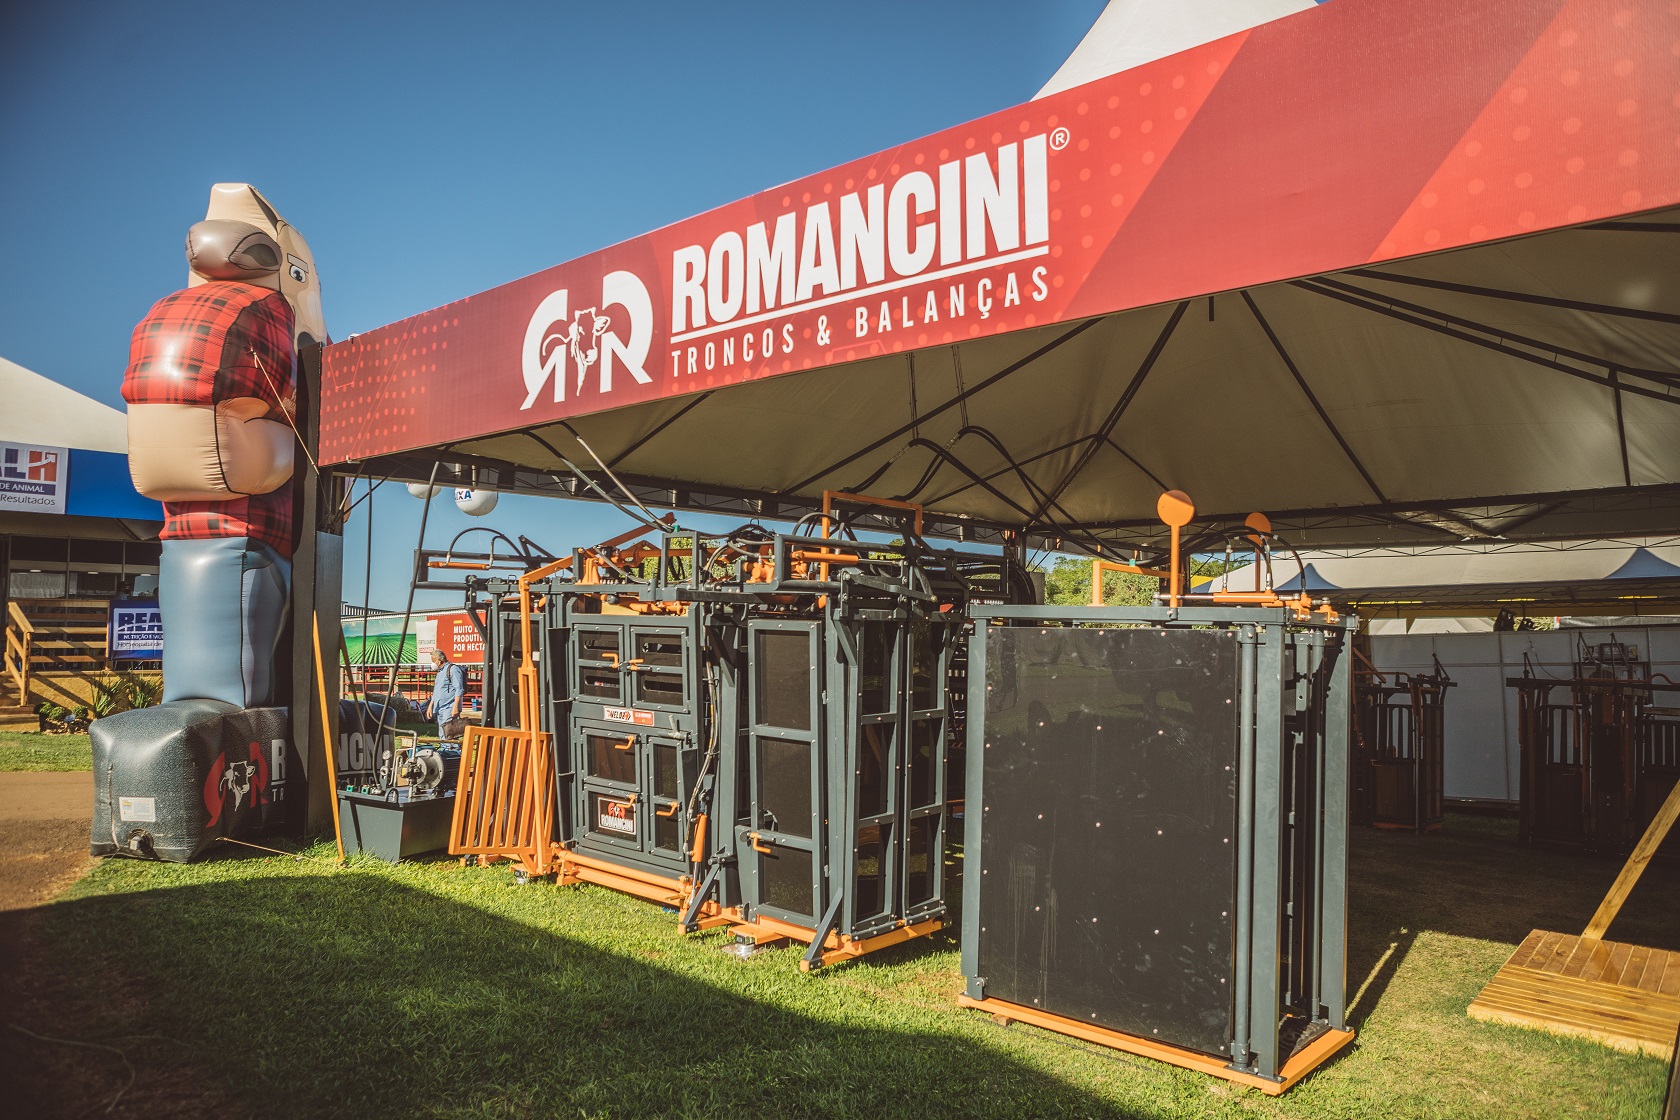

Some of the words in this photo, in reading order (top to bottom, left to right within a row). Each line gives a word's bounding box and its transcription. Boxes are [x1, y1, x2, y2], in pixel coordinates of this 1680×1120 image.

[671, 323, 794, 378] TRONCOS
[816, 314, 831, 347] &
[855, 265, 1049, 338] BALANÇAS
[12, 484, 45, 493] ANIMAL
[0, 493, 56, 505] Resultados
[453, 625, 473, 634] MUITO
[453, 643, 466, 651] POR
